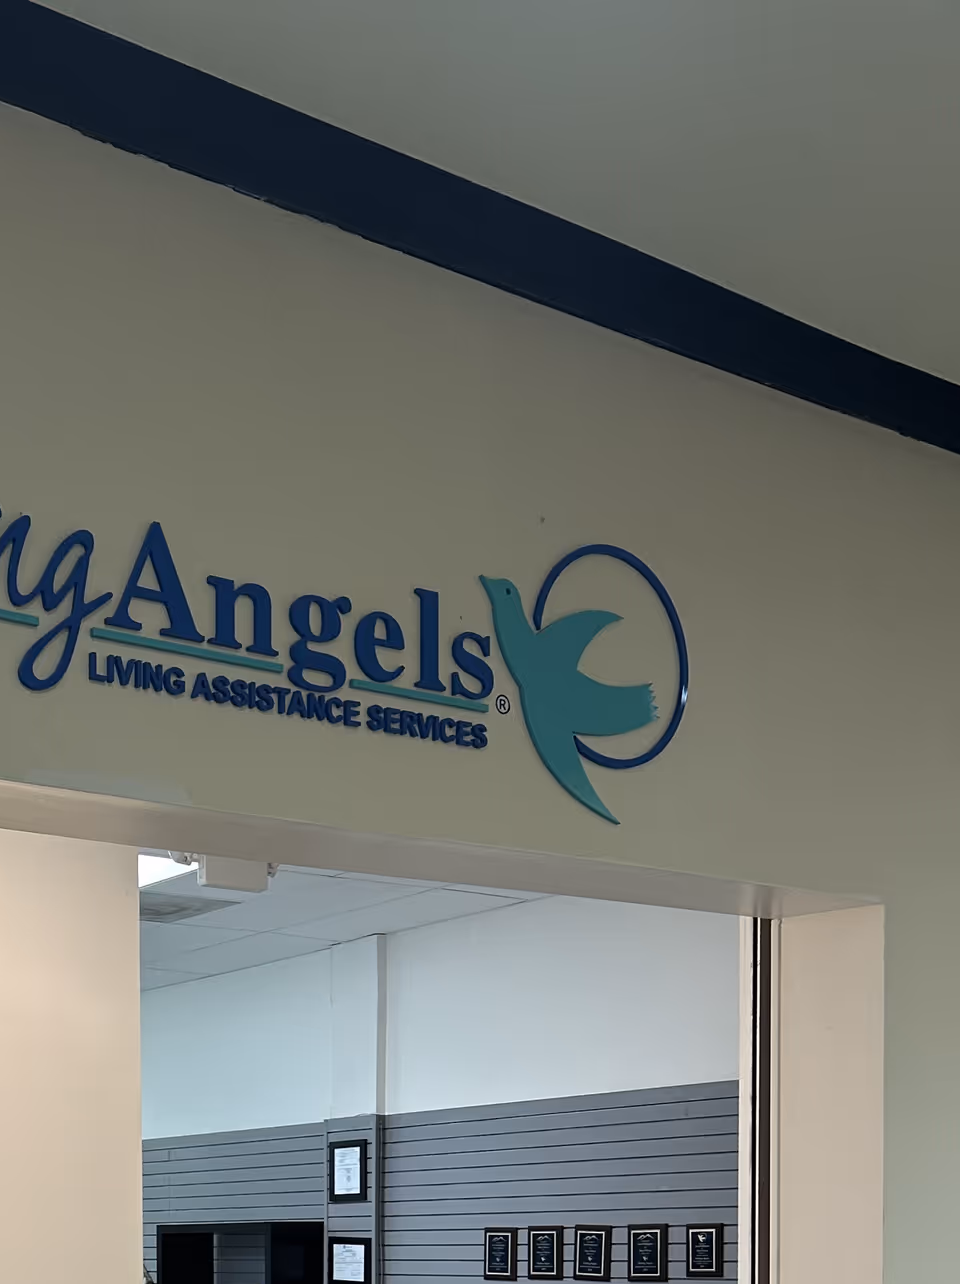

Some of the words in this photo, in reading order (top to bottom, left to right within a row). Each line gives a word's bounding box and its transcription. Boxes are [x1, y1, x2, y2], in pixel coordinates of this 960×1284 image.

[104, 521, 495, 700] Angels
[88, 651, 186, 696] LIVING
[190, 672, 362, 728] ASSISTANCE
[366, 704, 489, 749] SERVICES
